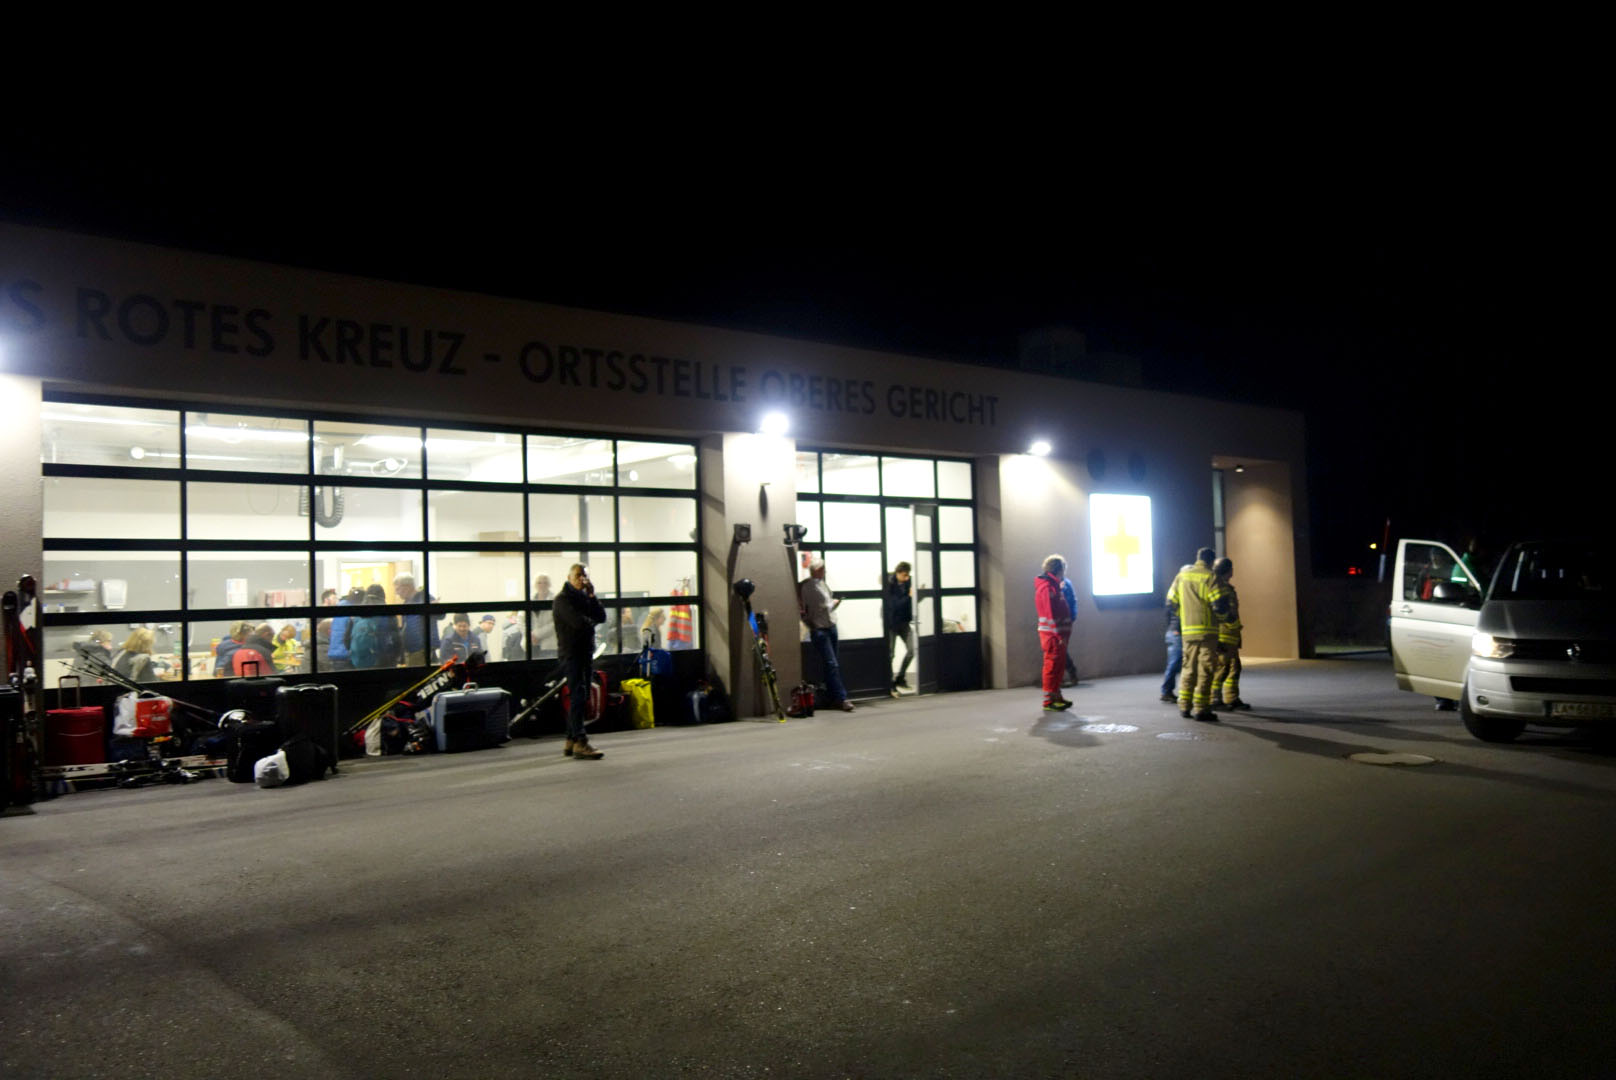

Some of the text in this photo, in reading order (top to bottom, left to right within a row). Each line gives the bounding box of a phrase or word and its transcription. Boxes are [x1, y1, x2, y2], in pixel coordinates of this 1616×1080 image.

[75, 286, 275, 357] ROTES
[299, 314, 467, 376] KREUZ
[519, 340, 747, 402] ORTSSTELLE
[759, 369, 876, 415] OBERES
[887, 384, 999, 427] GERICHT
